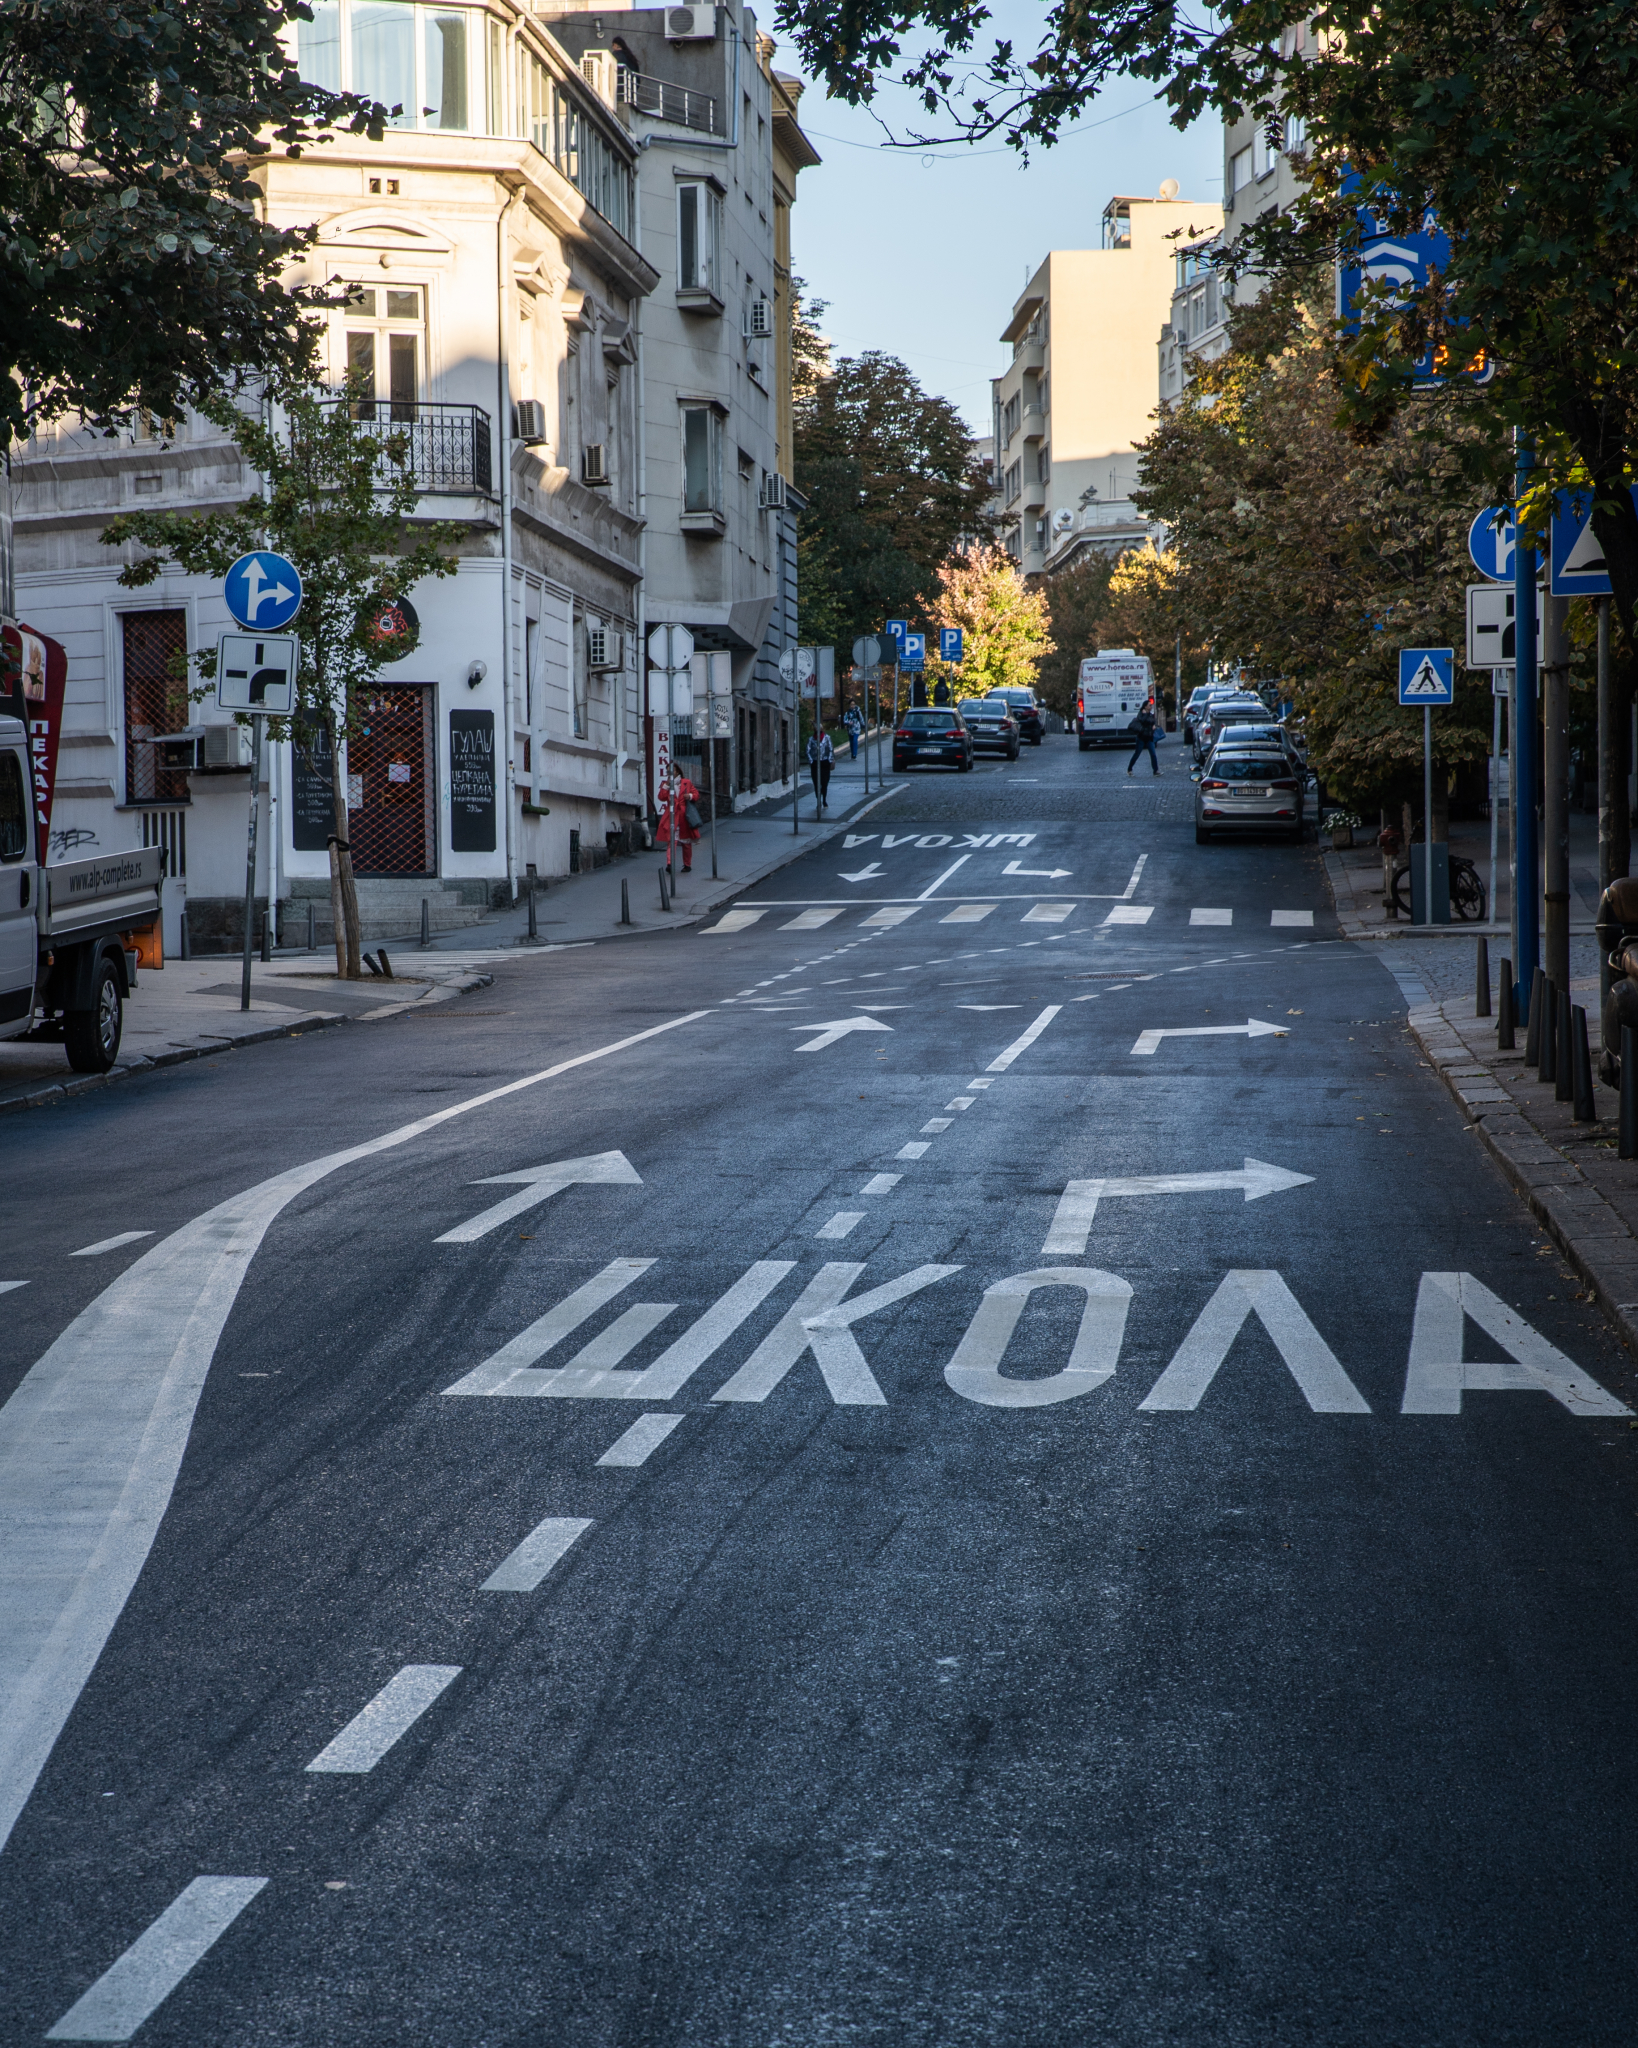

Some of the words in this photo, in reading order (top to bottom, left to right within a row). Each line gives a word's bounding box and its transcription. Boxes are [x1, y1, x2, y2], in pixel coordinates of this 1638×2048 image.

[905, 637, 919, 656] P
[944, 631, 958, 649] P
[30, 719, 49, 824] ПЕКАРА
[657, 733, 669, 813] BAKLAA
[841, 833, 1037, 849] ШКОЛА
[69, 859, 142, 893] www.alp-complete.rs
[439, 1257, 1636, 1417] ШКОЛА
